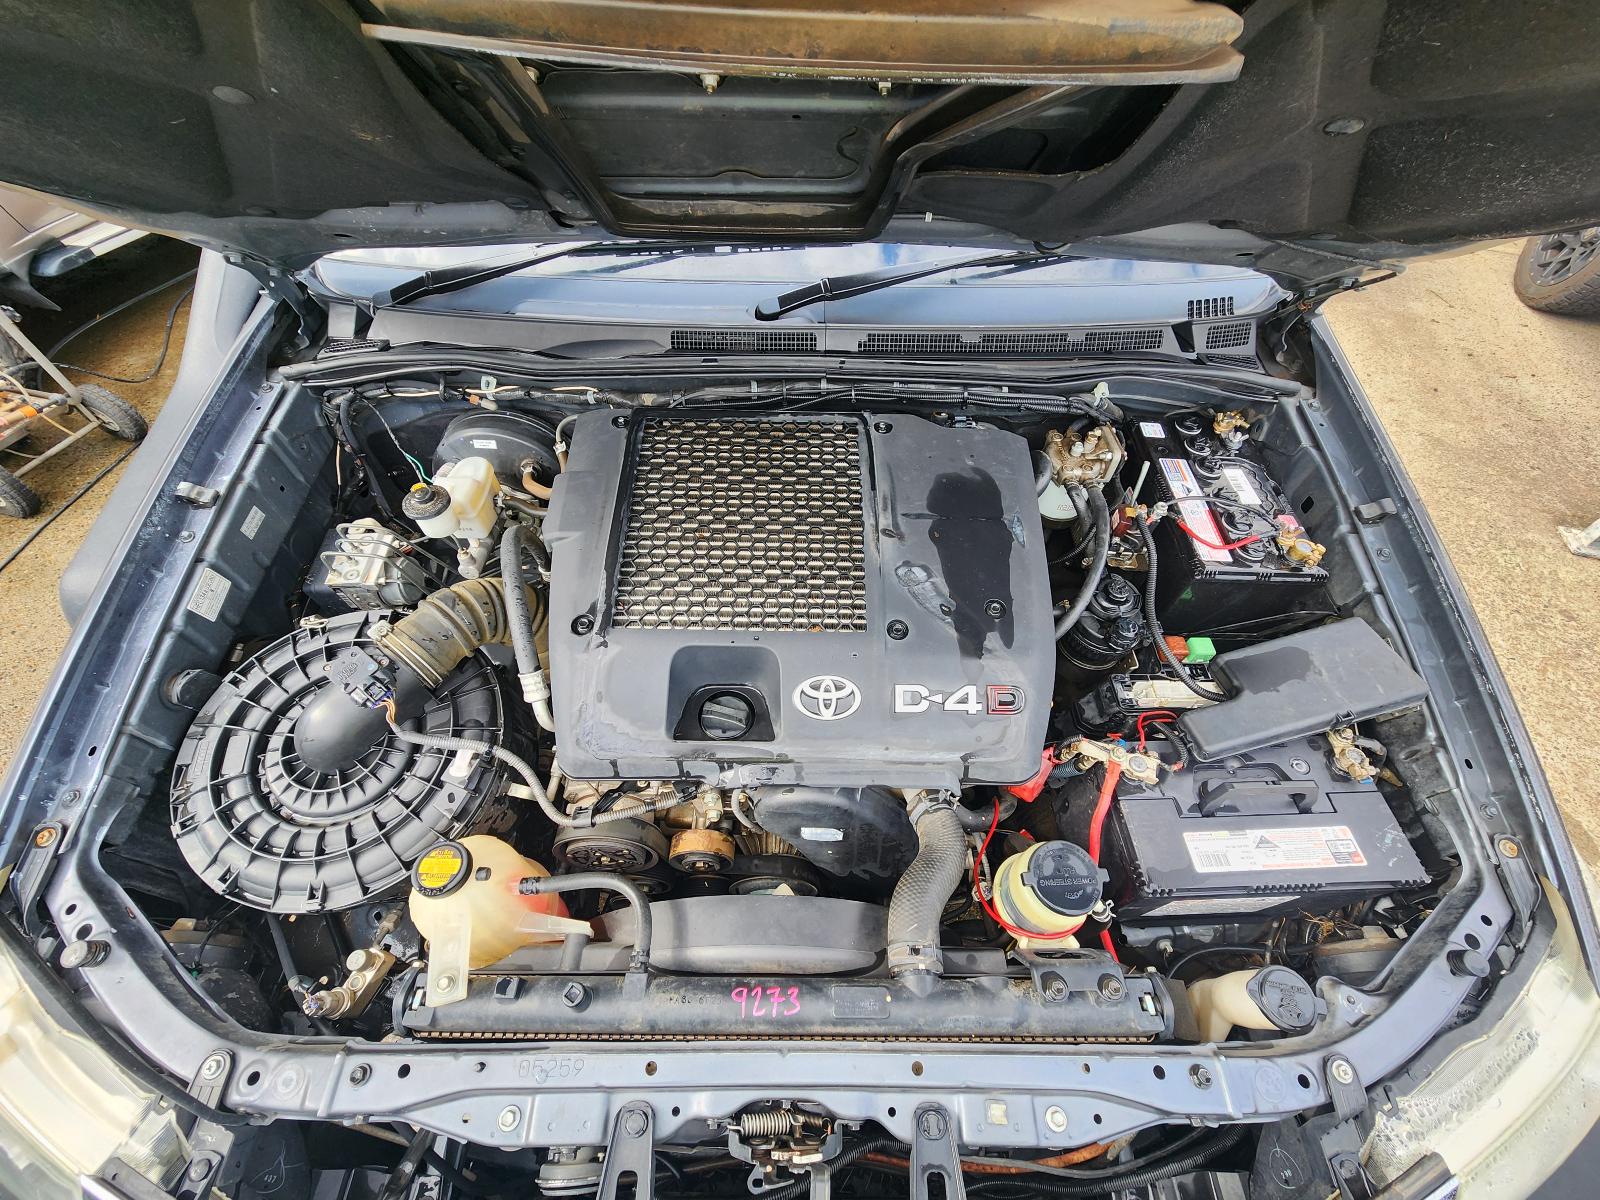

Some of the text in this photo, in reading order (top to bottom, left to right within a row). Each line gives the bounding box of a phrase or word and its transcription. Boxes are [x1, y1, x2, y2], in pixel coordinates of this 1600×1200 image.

[894, 684, 1025, 715] D-4D
[1039, 877, 1097, 887] POWER STEERING
[731, 986, 801, 1018] 9273
